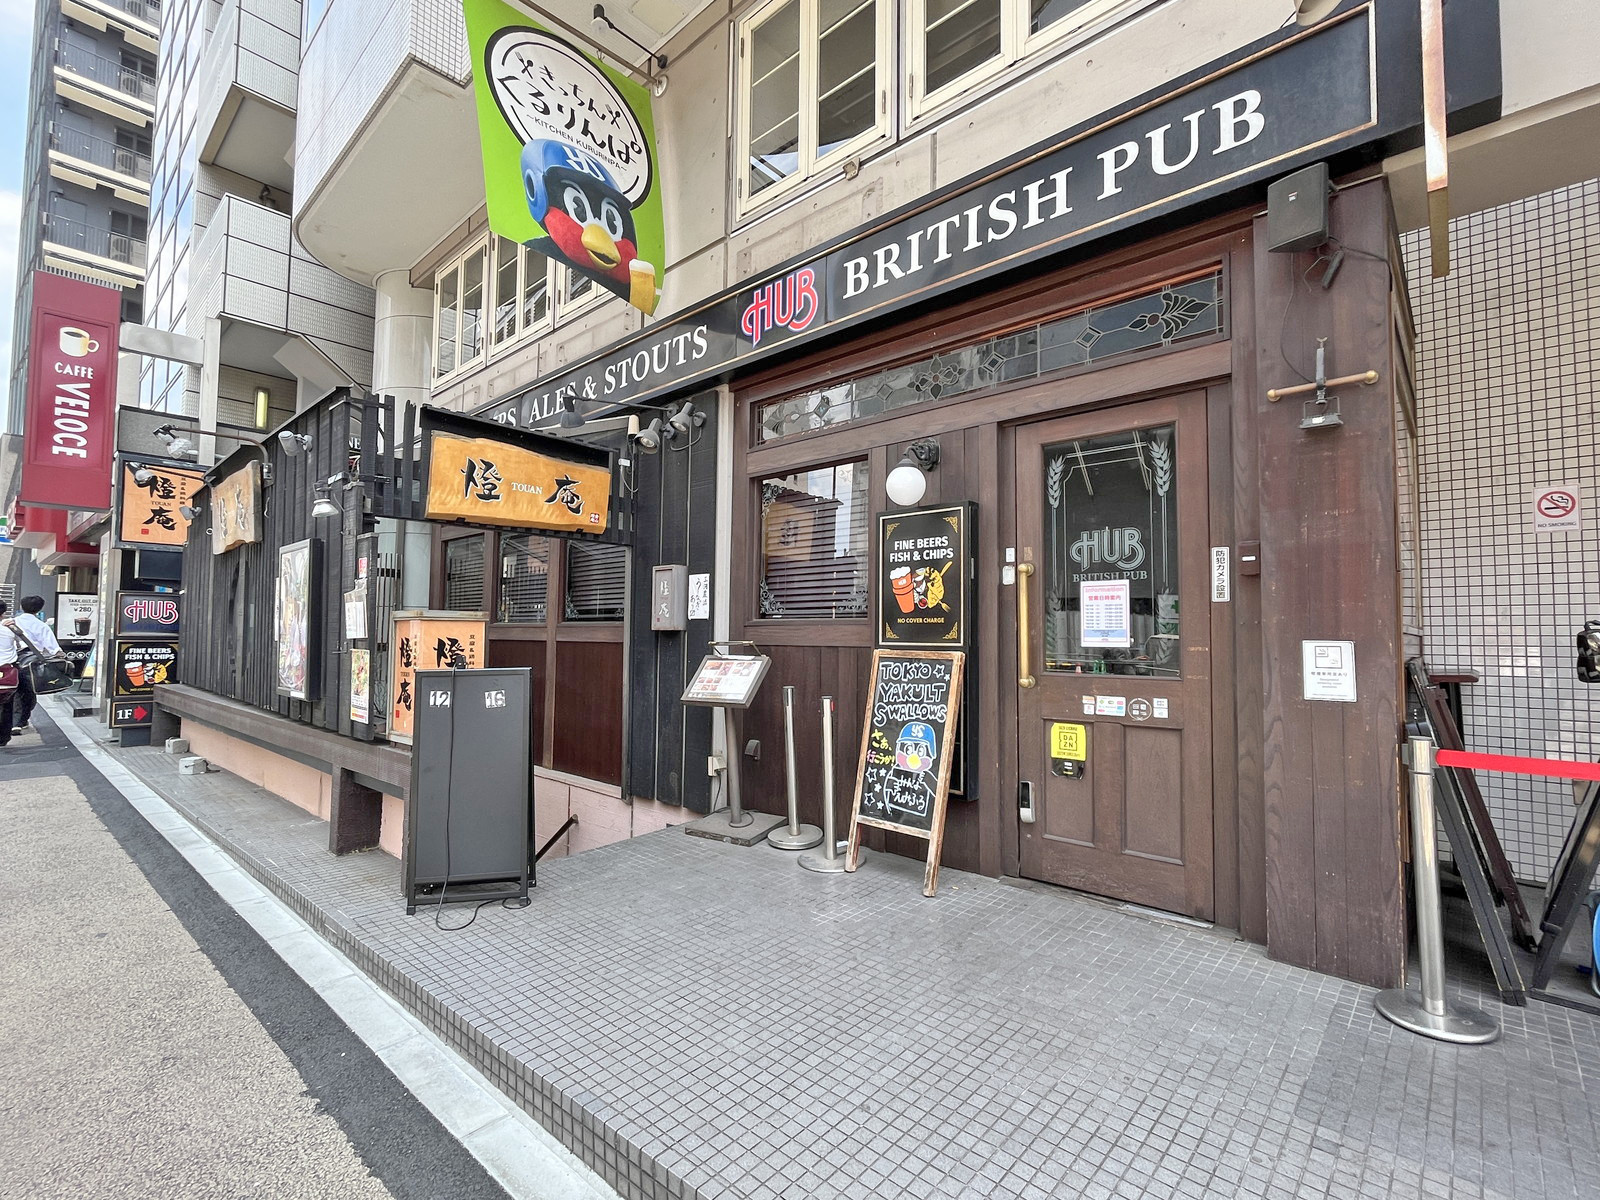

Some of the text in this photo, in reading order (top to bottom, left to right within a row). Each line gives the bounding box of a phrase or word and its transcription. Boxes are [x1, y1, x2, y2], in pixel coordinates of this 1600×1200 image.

[539, 63, 606, 121] きっちん
[497, 75, 643, 165] くるりんぱ
[843, 89, 1266, 300] BRITISH PUB
[741, 267, 819, 348] HUB
[529, 381, 575, 423] ALES
[582, 374, 598, 400] &
[604, 324, 709, 395] STOUTS
[52, 383, 91, 458] VELOCE
[511, 481, 543, 495] TOUAN
[890, 548, 954, 563] FISH & CHIPS
[894, 536, 949, 551] FINE BEERS
[1070, 526, 1146, 572] HUB
[1073, 571, 1148, 582] BRITISH PUB
[1215, 550, 1226, 598] 防犯カメラ設置
[124, 600, 179, 624] HUB
[880, 662, 932, 682] TOKYO
[879, 683, 947, 703] YAKULT
[117, 709, 132, 720] 1F
[873, 703, 948, 727] SWALLOWS
